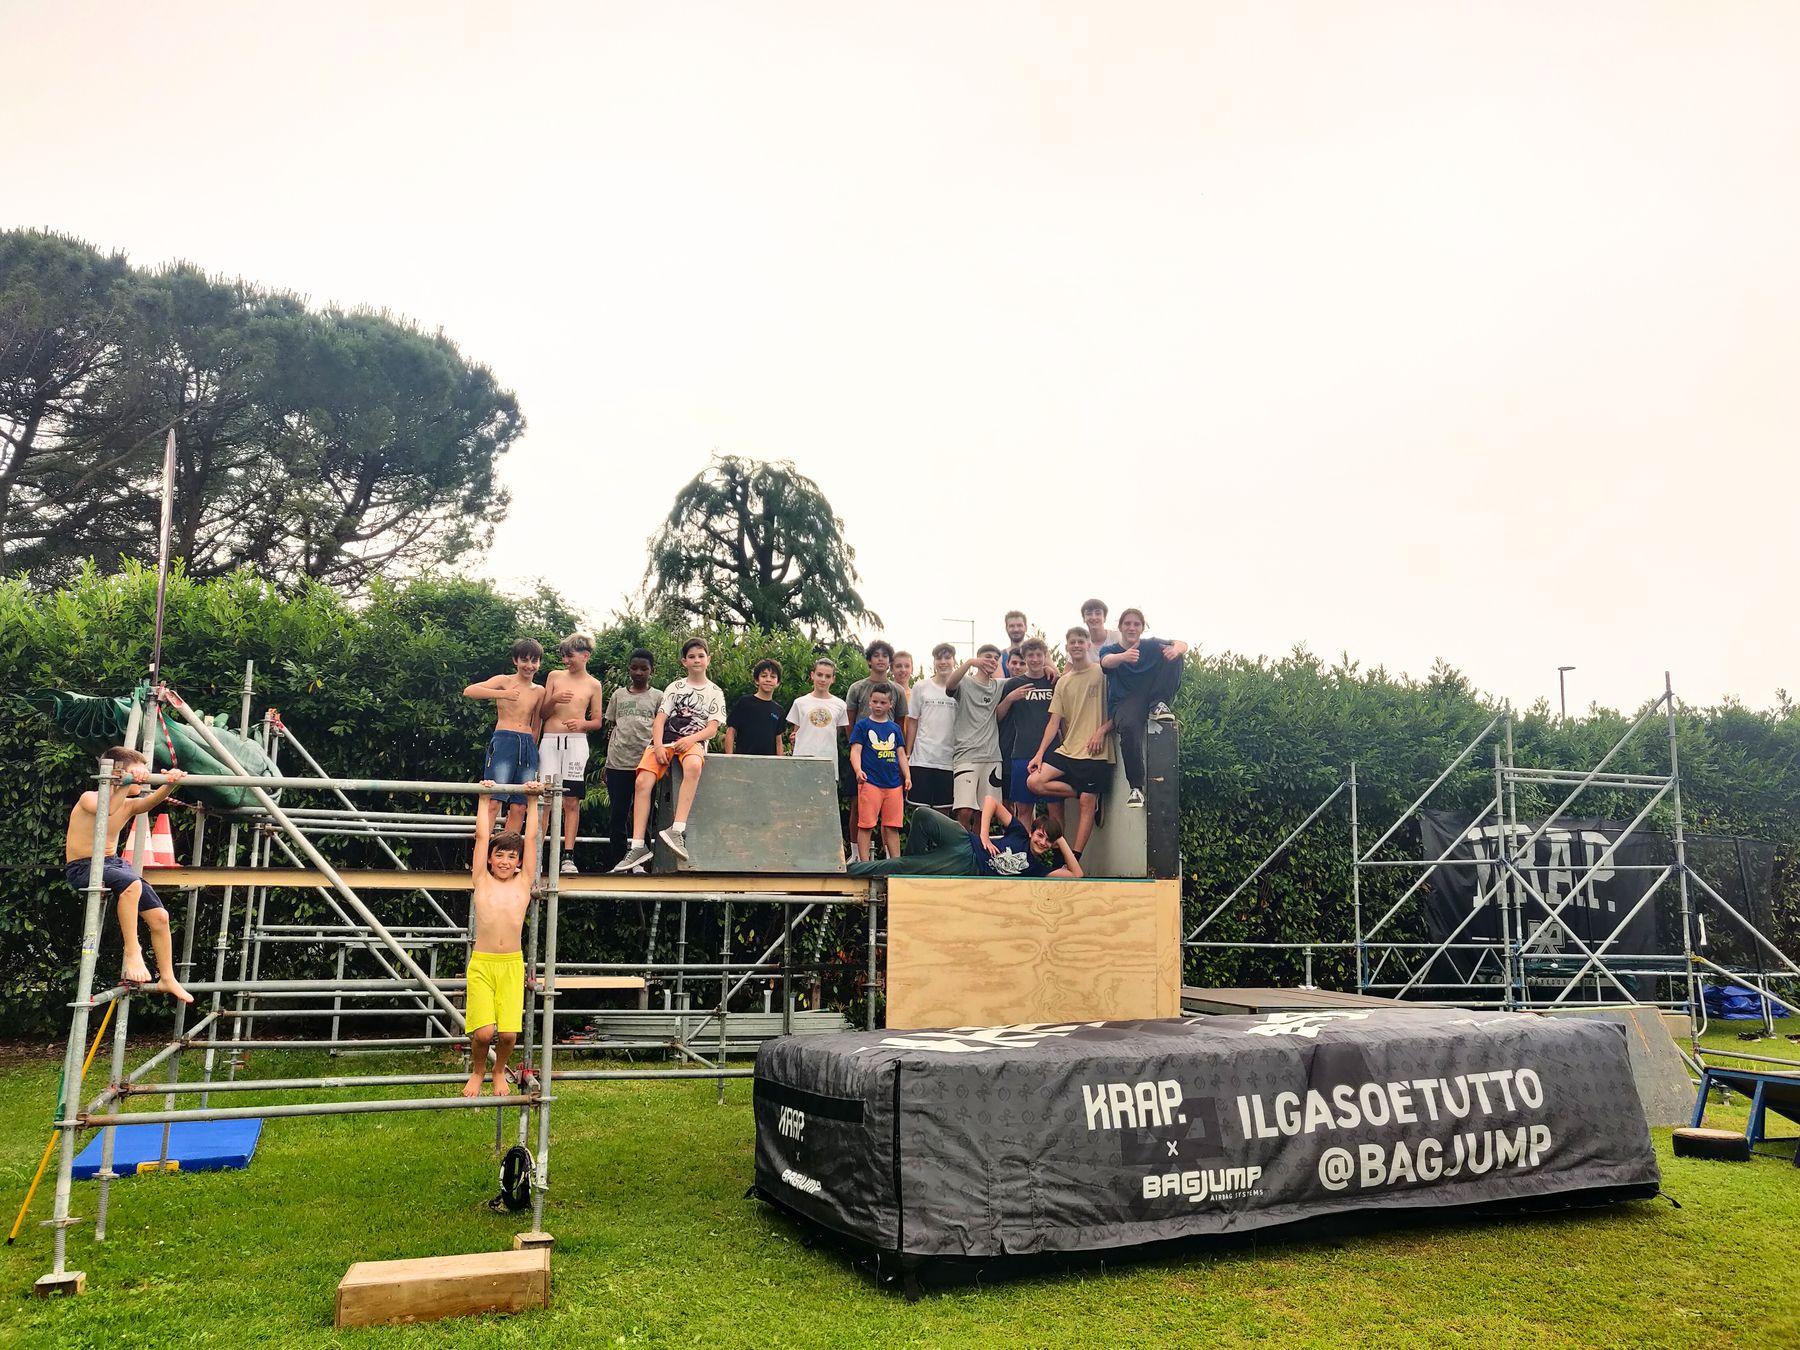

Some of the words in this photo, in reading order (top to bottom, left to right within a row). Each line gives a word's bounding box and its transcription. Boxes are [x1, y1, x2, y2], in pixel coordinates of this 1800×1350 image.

[1025, 690, 1053, 701] VANS
[778, 1105, 805, 1142] KRAP.
[1082, 1079, 1187, 1131] KRAP.
[1318, 1124, 1552, 1191] @BAGJUMP
[1142, 1166, 1262, 1203] BAGJUMP
